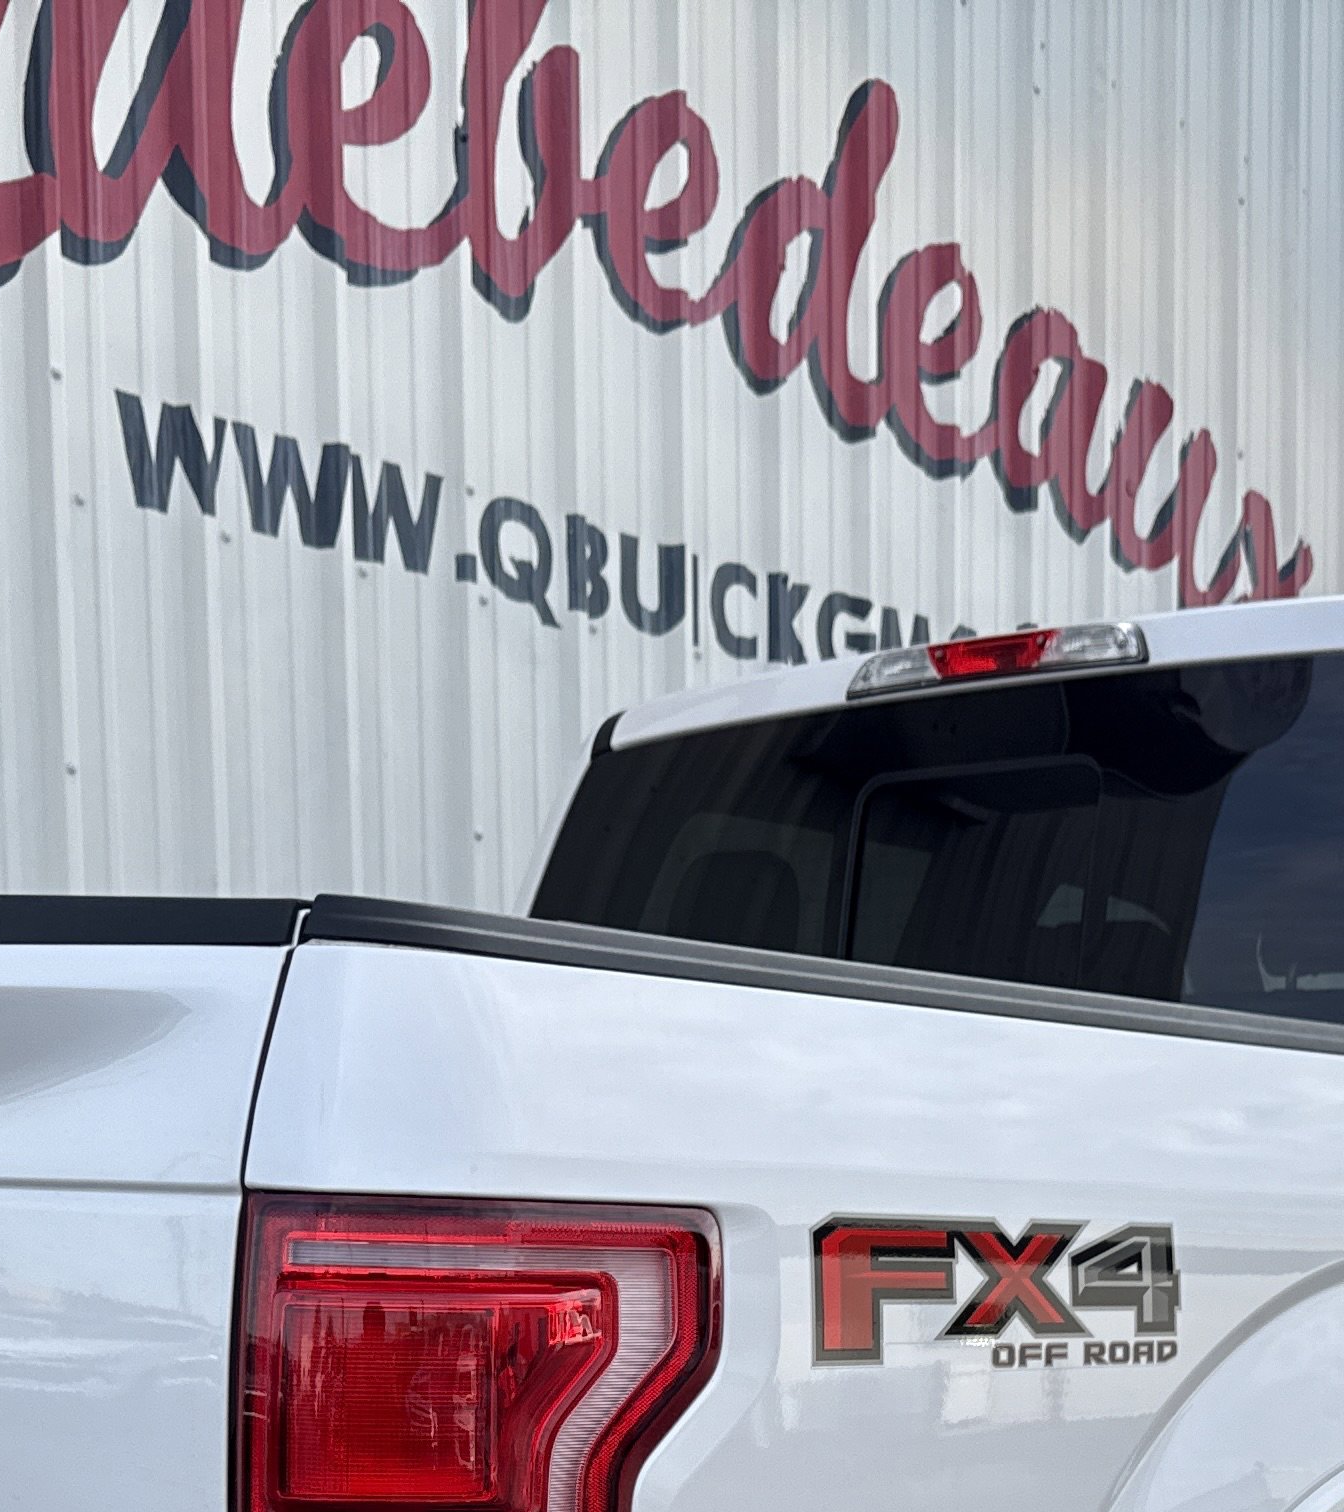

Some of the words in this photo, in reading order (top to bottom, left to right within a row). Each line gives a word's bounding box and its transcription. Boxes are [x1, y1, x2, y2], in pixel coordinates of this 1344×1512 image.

[809, 1212, 1182, 1367] FX4
[991, 1341, 1069, 1368] OFF
[1082, 1339, 1178, 1366] ROAD
